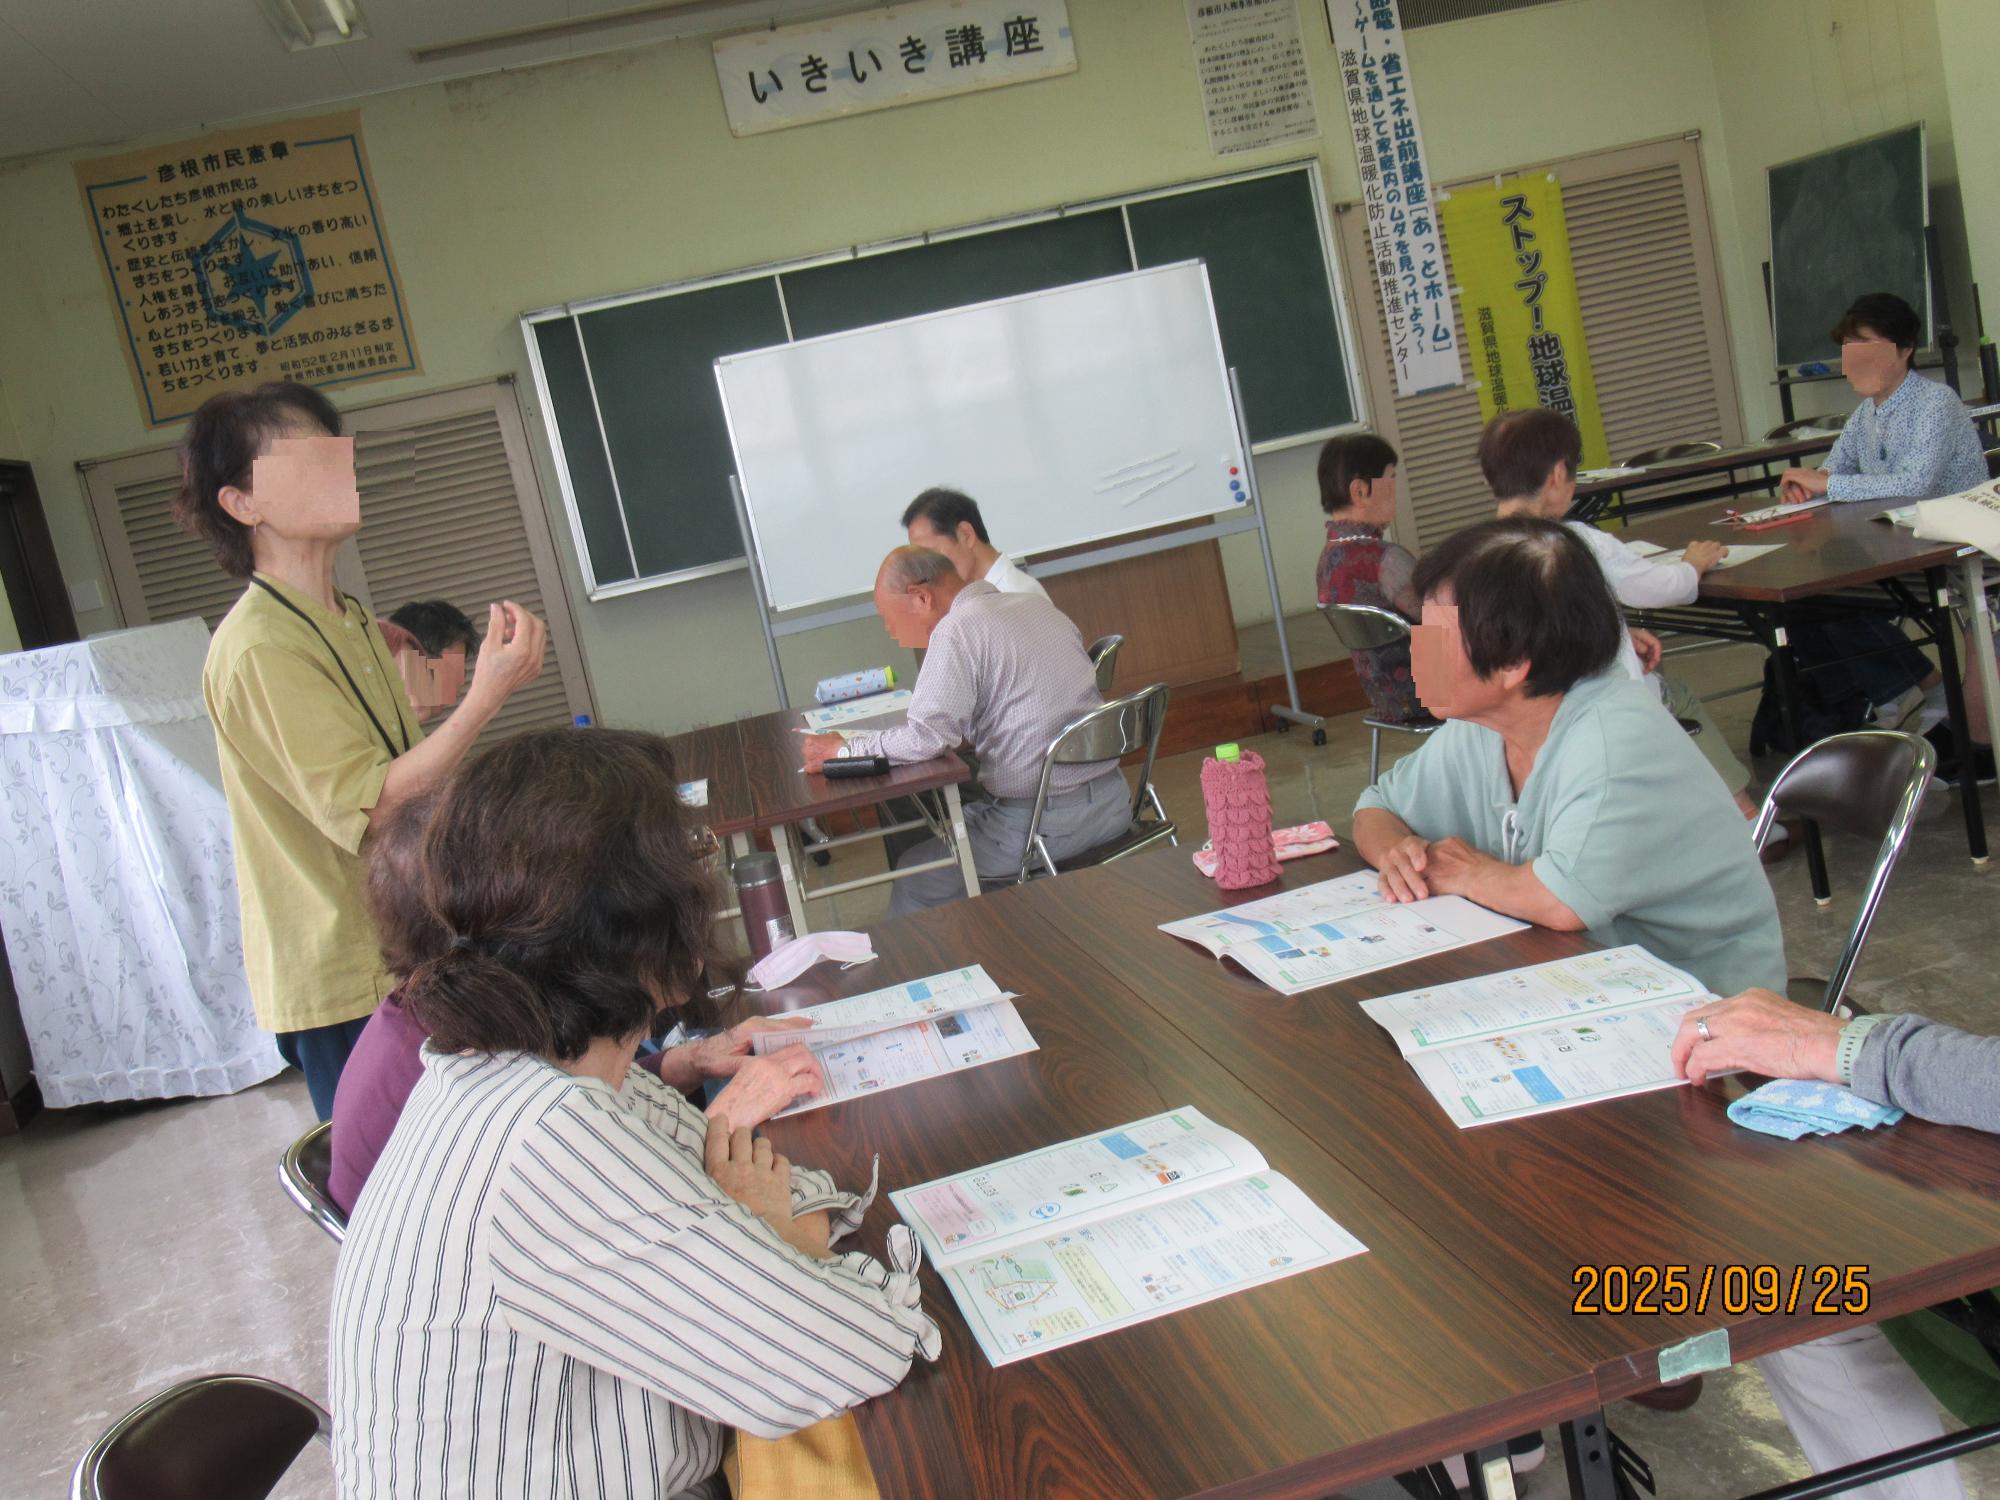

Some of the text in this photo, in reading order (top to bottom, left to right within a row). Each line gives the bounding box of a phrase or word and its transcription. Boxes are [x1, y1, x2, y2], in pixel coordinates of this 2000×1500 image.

[748, 15, 1044, 104] いきいき講座
[157, 140, 290, 184] 彦根市民憲章
[102, 176, 258, 219] わたくしたち彦根市民は
[1340, 48, 1410, 380] 滋賀県地球温暖化防止活動推進センター
